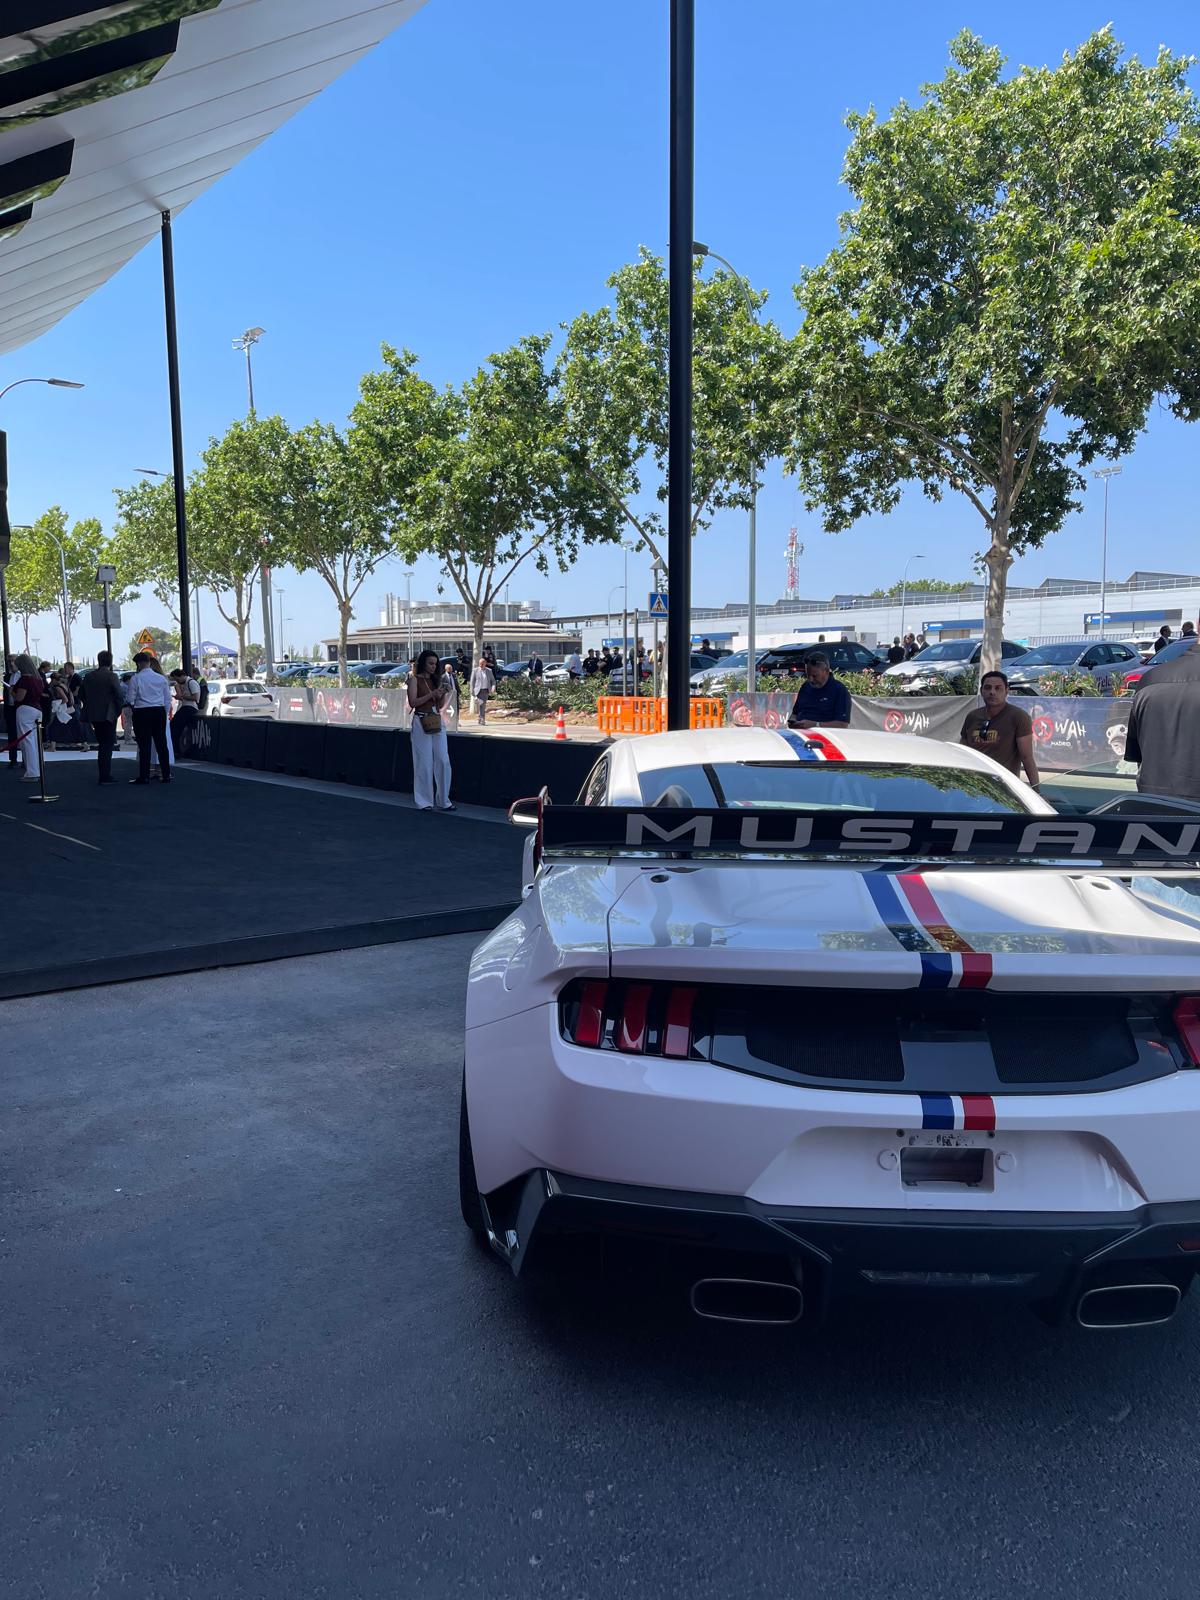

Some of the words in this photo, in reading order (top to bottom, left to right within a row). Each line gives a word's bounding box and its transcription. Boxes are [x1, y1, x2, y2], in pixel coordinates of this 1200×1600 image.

[923, 623, 929, 631] 5
[1086, 615, 1092, 624] 4
[904, 711, 930, 732] WAH
[1055, 718, 1087, 741] WAH
[191, 718, 212, 750] WAH
[625, 813, 1200, 856] MUSTAN
